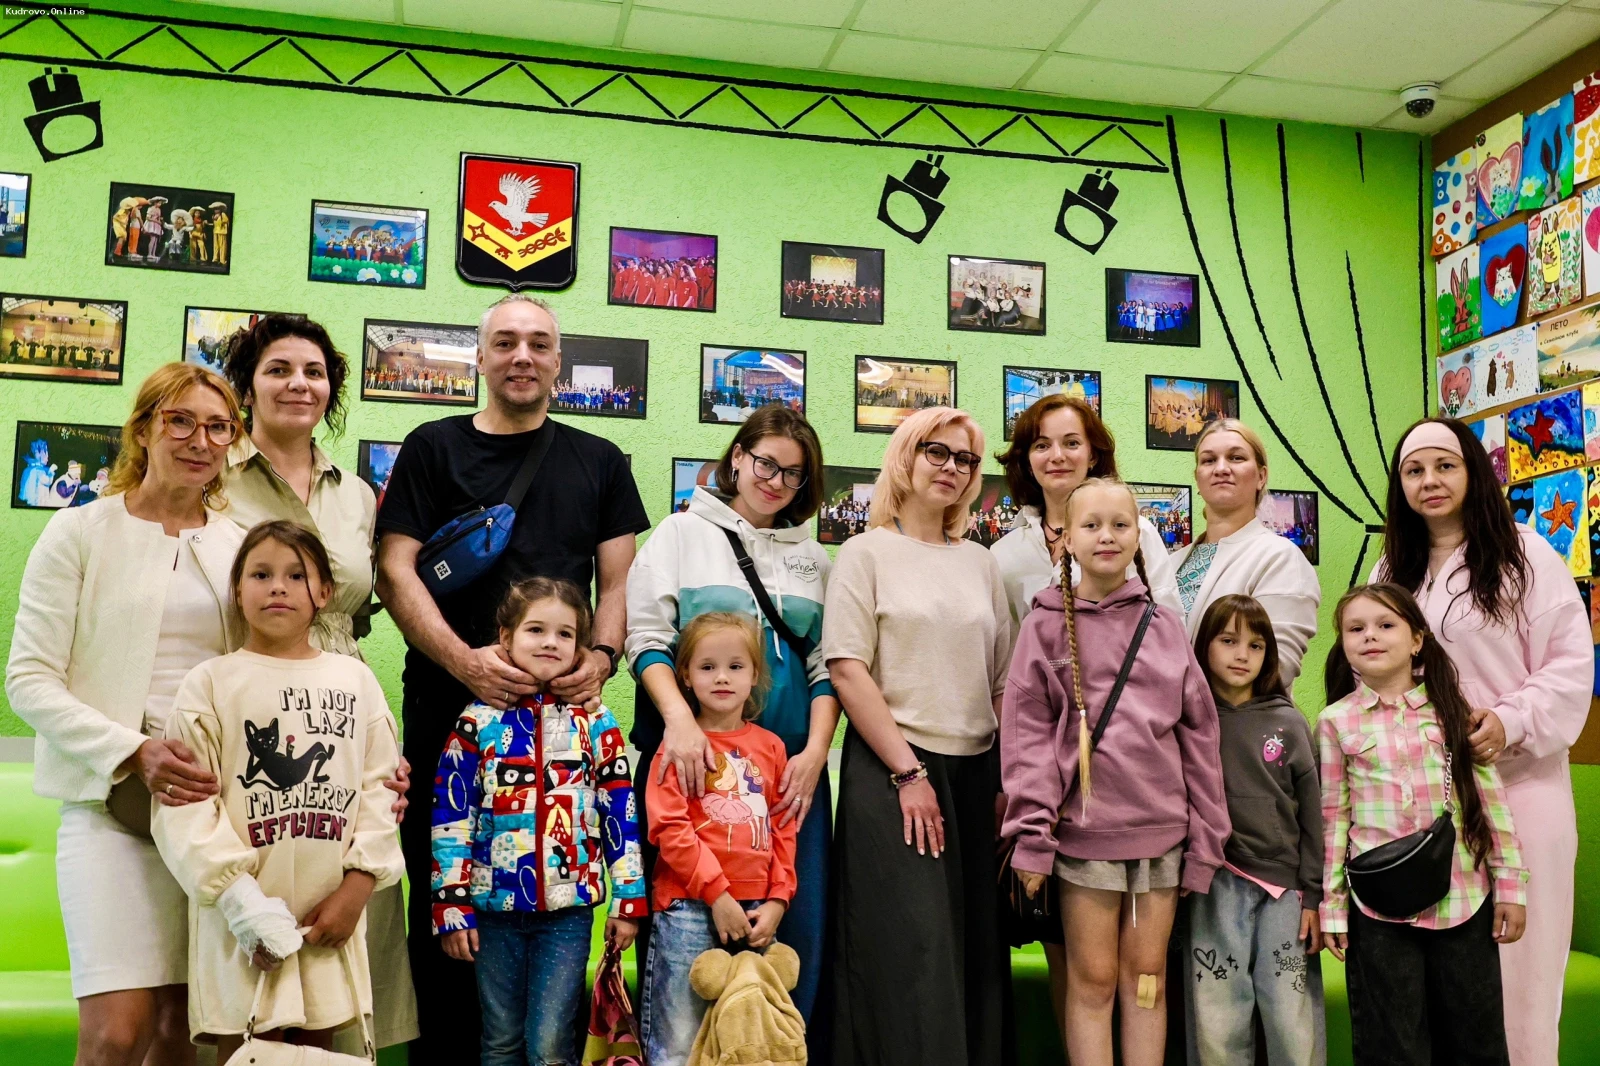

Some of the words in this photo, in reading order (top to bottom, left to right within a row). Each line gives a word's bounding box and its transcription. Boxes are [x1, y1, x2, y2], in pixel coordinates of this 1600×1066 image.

[1550, 319, 1568, 331] ЛЕТО
[279, 687, 311, 711] I'M
[317, 687, 357, 715] NOT
[245, 792, 275, 820] I'M
[277, 781, 357, 814] ENERGY
